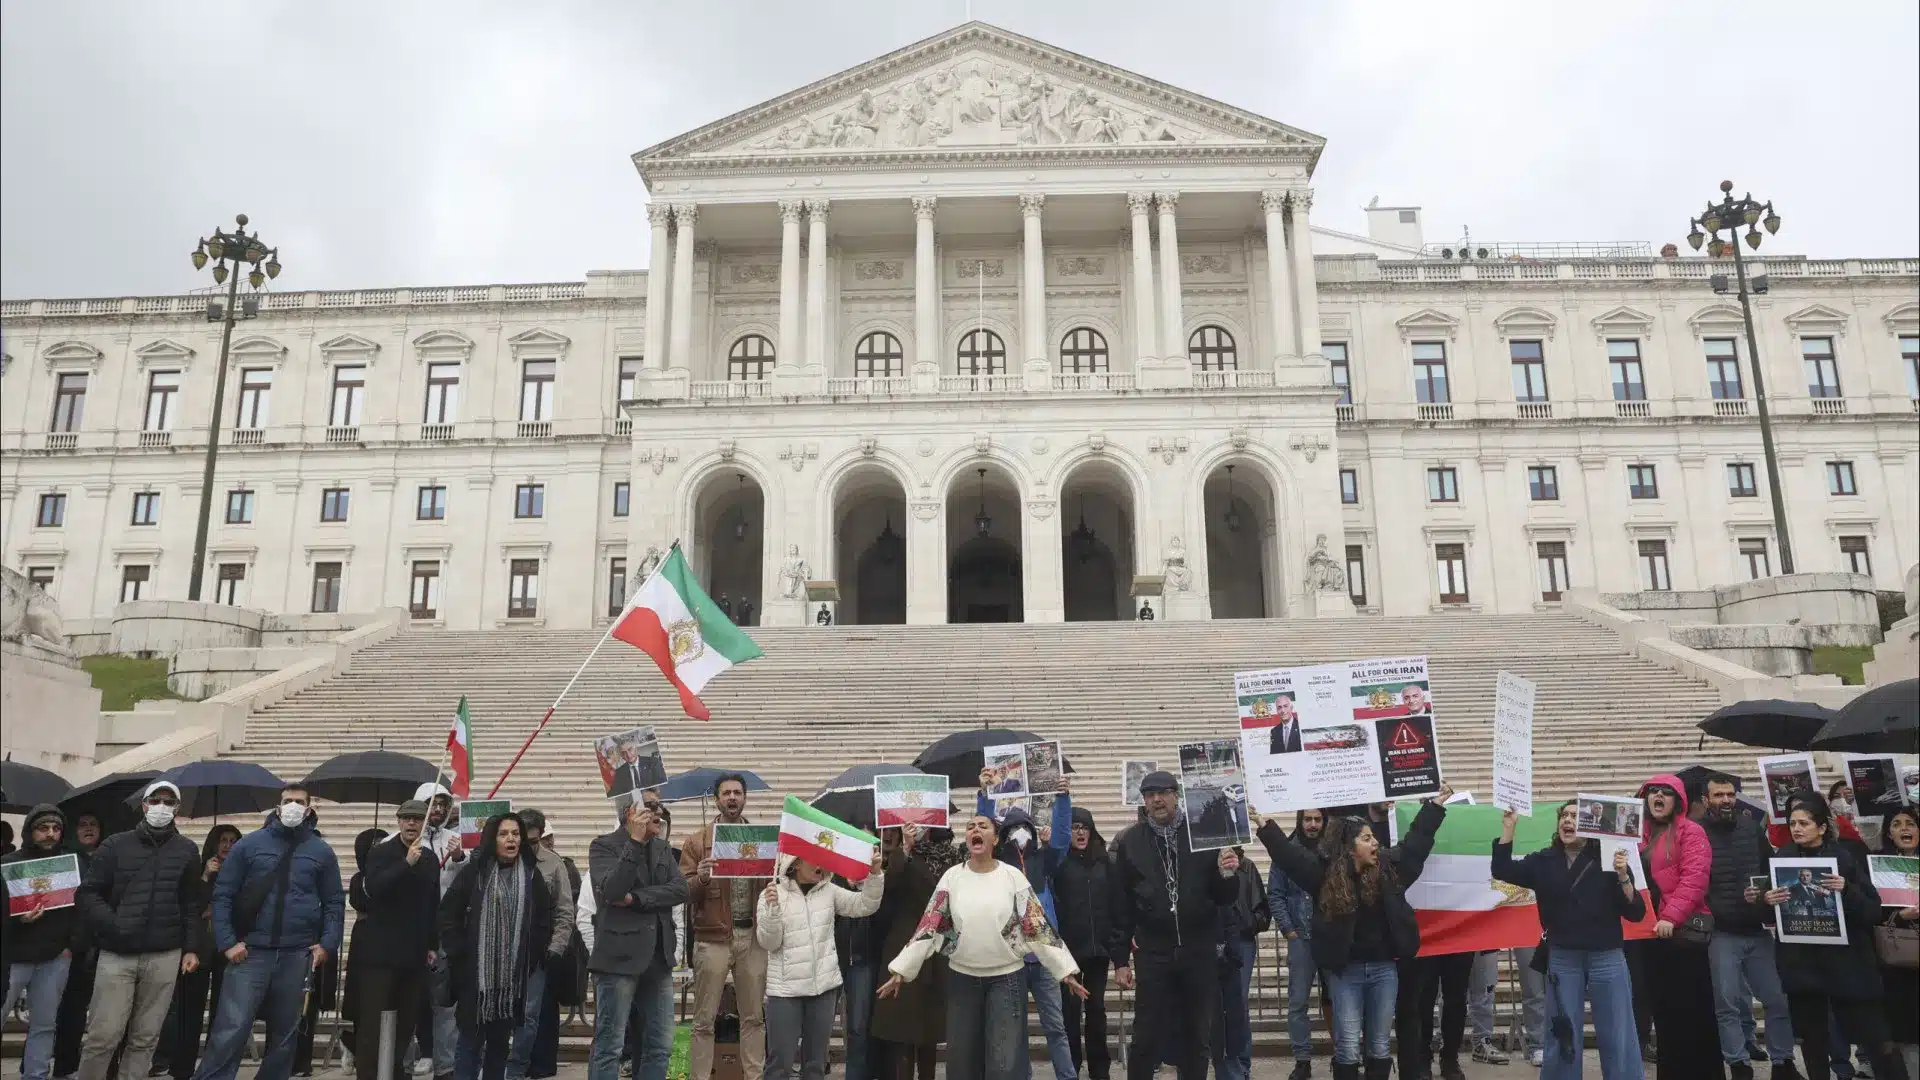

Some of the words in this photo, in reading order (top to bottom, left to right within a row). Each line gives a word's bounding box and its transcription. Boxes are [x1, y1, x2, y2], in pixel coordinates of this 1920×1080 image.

[1352, 671, 1367, 679] ALL
[1400, 666, 1423, 674] IRAN
[1239, 682, 1250, 690] ALL
